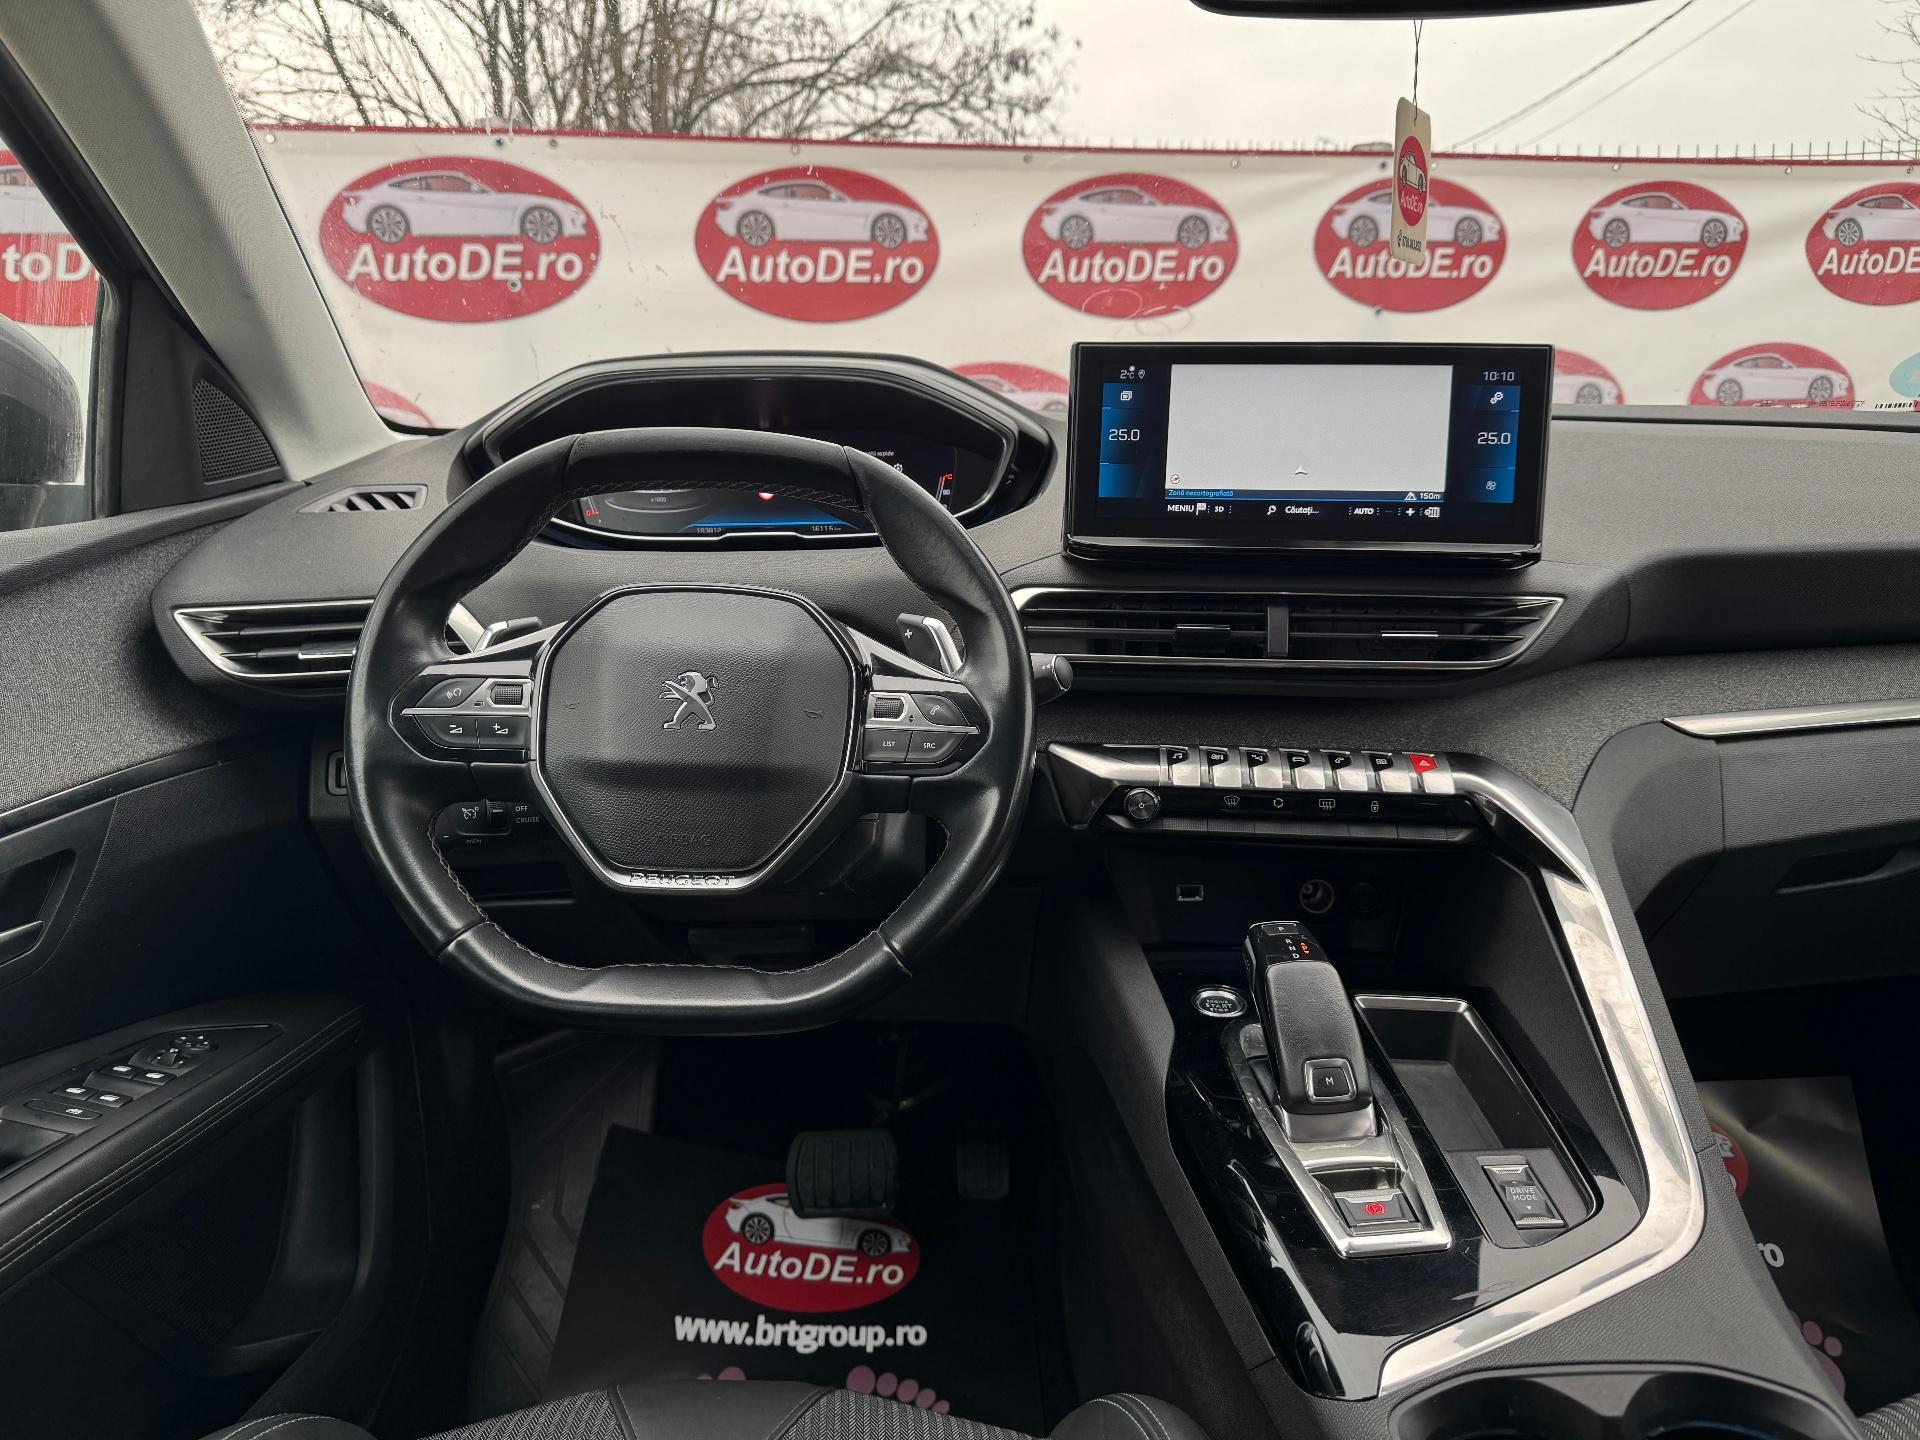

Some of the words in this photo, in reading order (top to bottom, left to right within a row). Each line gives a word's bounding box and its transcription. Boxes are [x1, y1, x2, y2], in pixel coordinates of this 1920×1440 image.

[349, 243, 584, 281] AutoDE.ro
[715, 246, 925, 284] AutoDE.ro
[1038, 248, 1225, 283] AutoDE.ro
[1583, 248, 1731, 278] AutoDE.ro
[1482, 371, 1515, 381] 10:10
[1108, 429, 1140, 441] 25.0
[1477, 432, 1511, 445] 25.0
[1167, 504, 1195, 512] MENIU
[1354, 507, 1375, 515] AUTO
[629, 872, 735, 886] PEUGEOT
[1325, 1076, 1335, 1086] M
[714, 1242, 905, 1285] AutoDE.ro
[674, 1314, 928, 1354] www.brtgroup.ro
